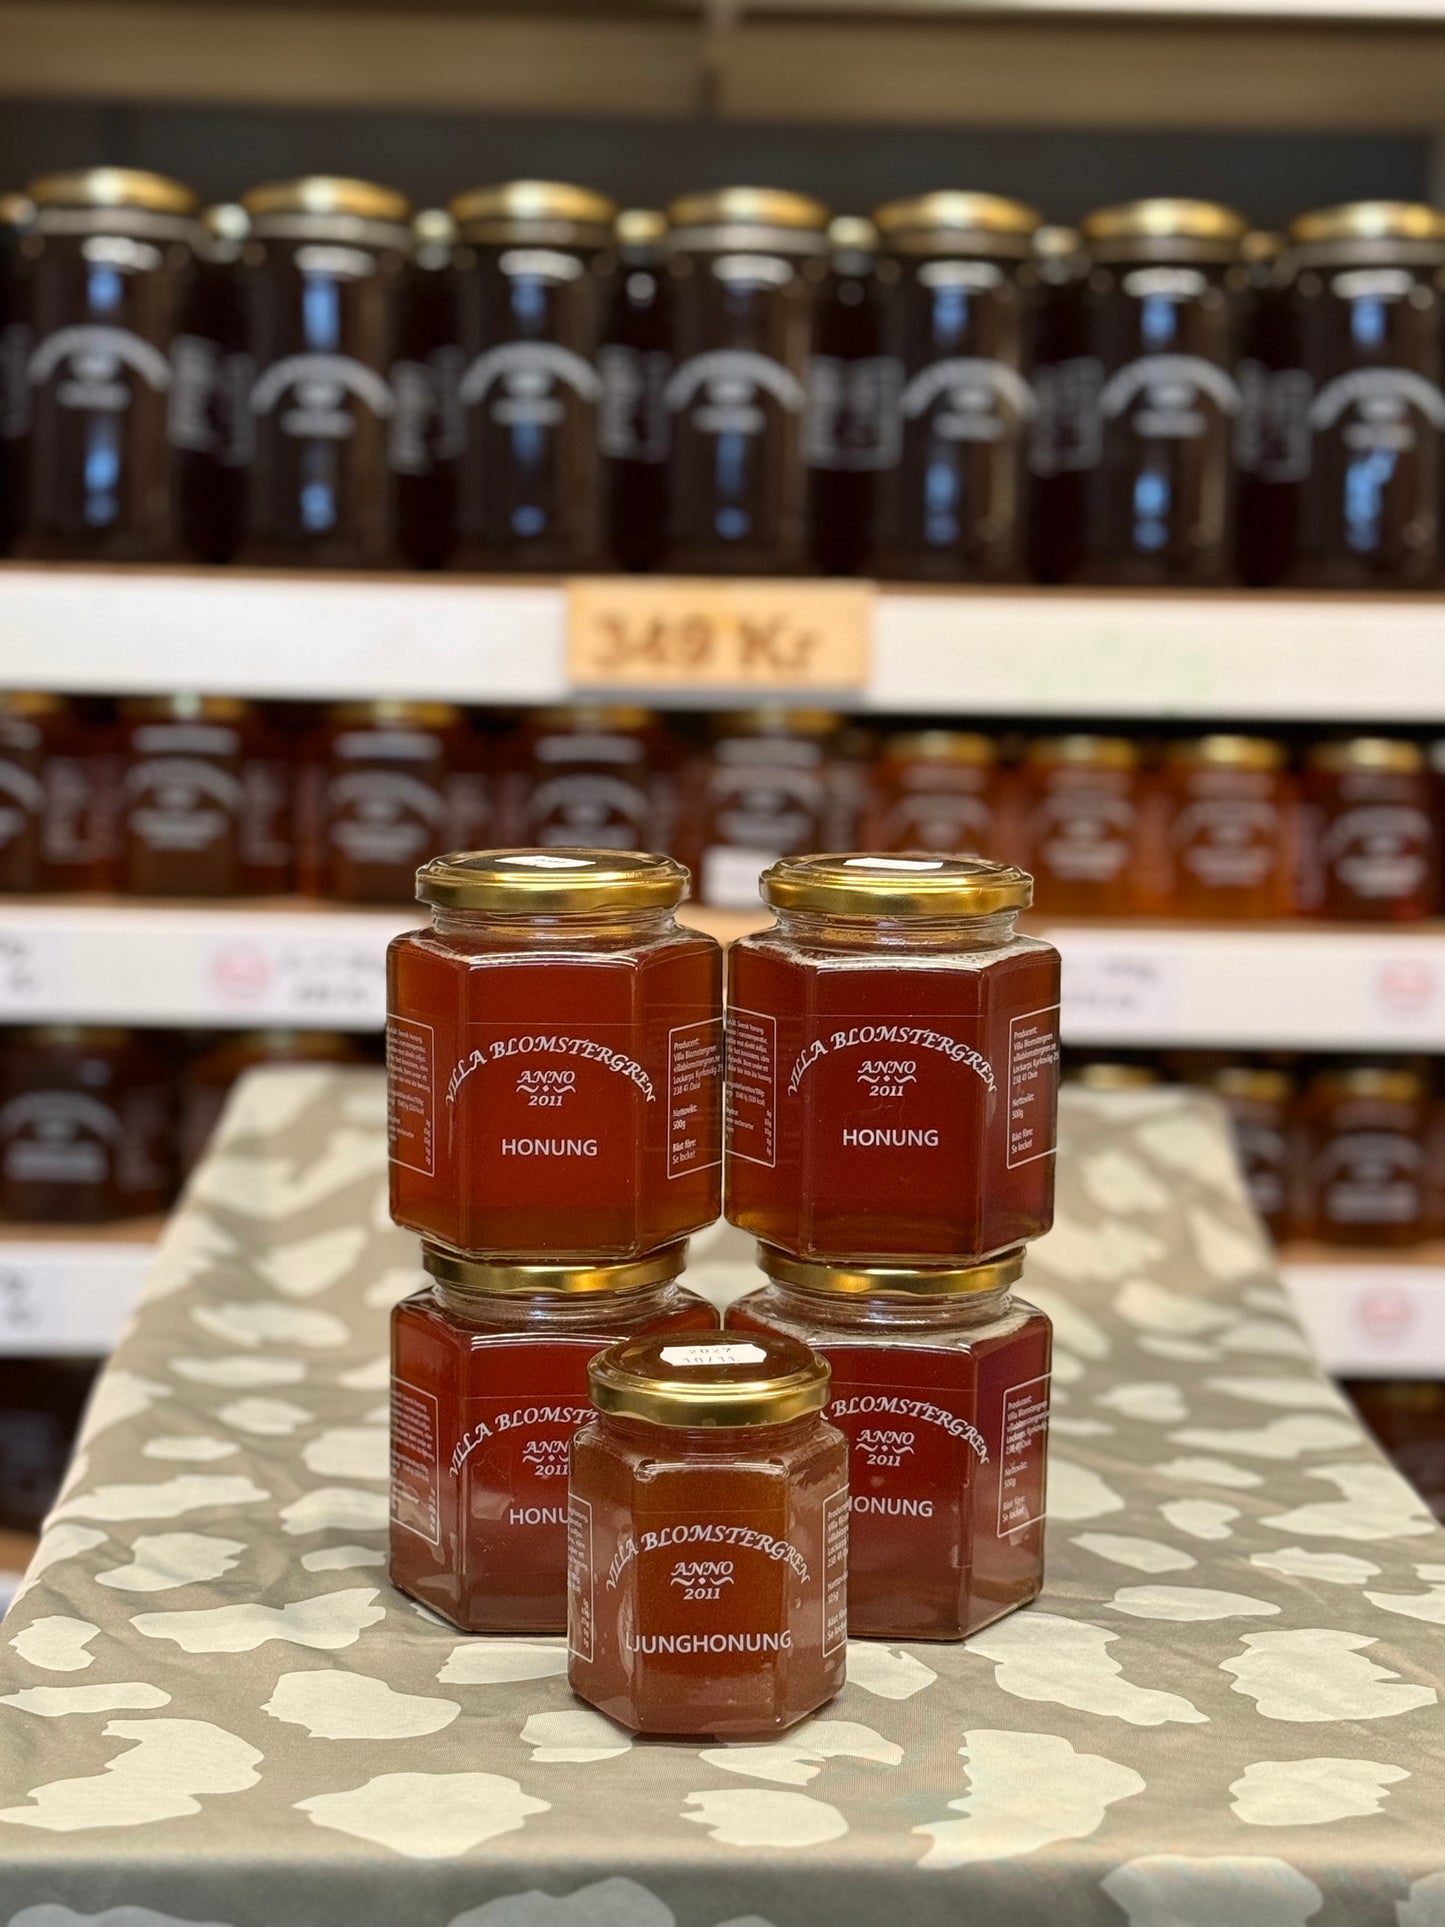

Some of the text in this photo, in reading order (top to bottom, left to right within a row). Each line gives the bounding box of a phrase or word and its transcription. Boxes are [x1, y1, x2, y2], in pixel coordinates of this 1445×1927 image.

[787, 1040, 829, 1096] VILLA
[830, 1025, 997, 1093] BLOMSTERGREN
[857, 1060, 917, 1074] ANNO
[446, 1050, 488, 1106] VILLA
[489, 1035, 656, 1103] BLOMSTERGREN
[516, 1070, 576, 1084] ANNO
[869, 1085, 904, 1097] 2011
[528, 1095, 563, 1106] 2011
[842, 1128, 939, 1147] HONUNG
[501, 1138, 598, 1156] HONUNG
[831, 1395, 990, 1465] BLOMSTERGREN
[857, 1429, 915, 1445] ANNO
[450, 1422, 494, 1478] VILLA
[866, 1454, 901, 1467] 2011
[534, 1465, 568, 1476] 2011
[606, 1525, 811, 1592] VILLA BLOMSTERGREN
[671, 1561, 734, 1576] ANNO
[683, 1587, 721, 1600] 2011
[626, 1630, 792, 1653] LJUNGHONUNG
